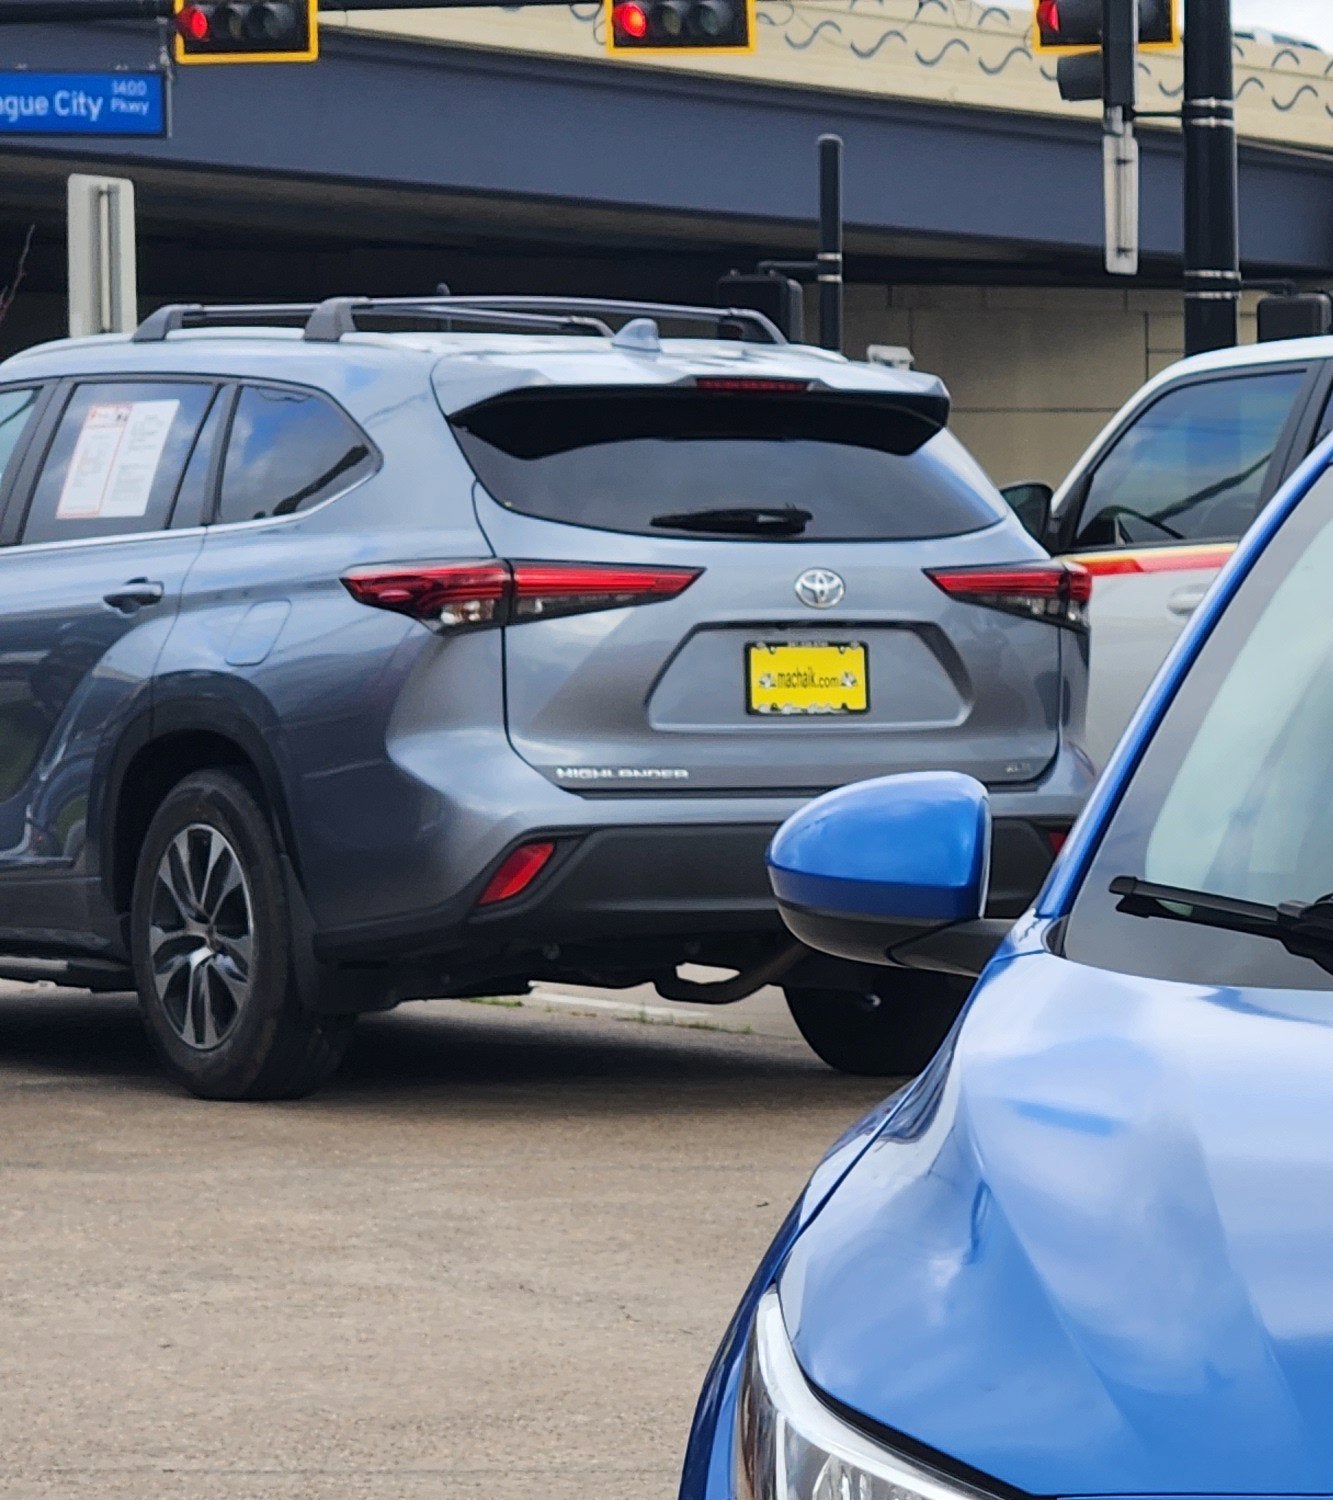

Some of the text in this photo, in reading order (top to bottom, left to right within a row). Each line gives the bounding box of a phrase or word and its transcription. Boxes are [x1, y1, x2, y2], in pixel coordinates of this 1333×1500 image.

[54, 89, 104, 121] City
[111, 98, 149, 115] Pkwy
[556, 767, 689, 780] HIGHLANDER
